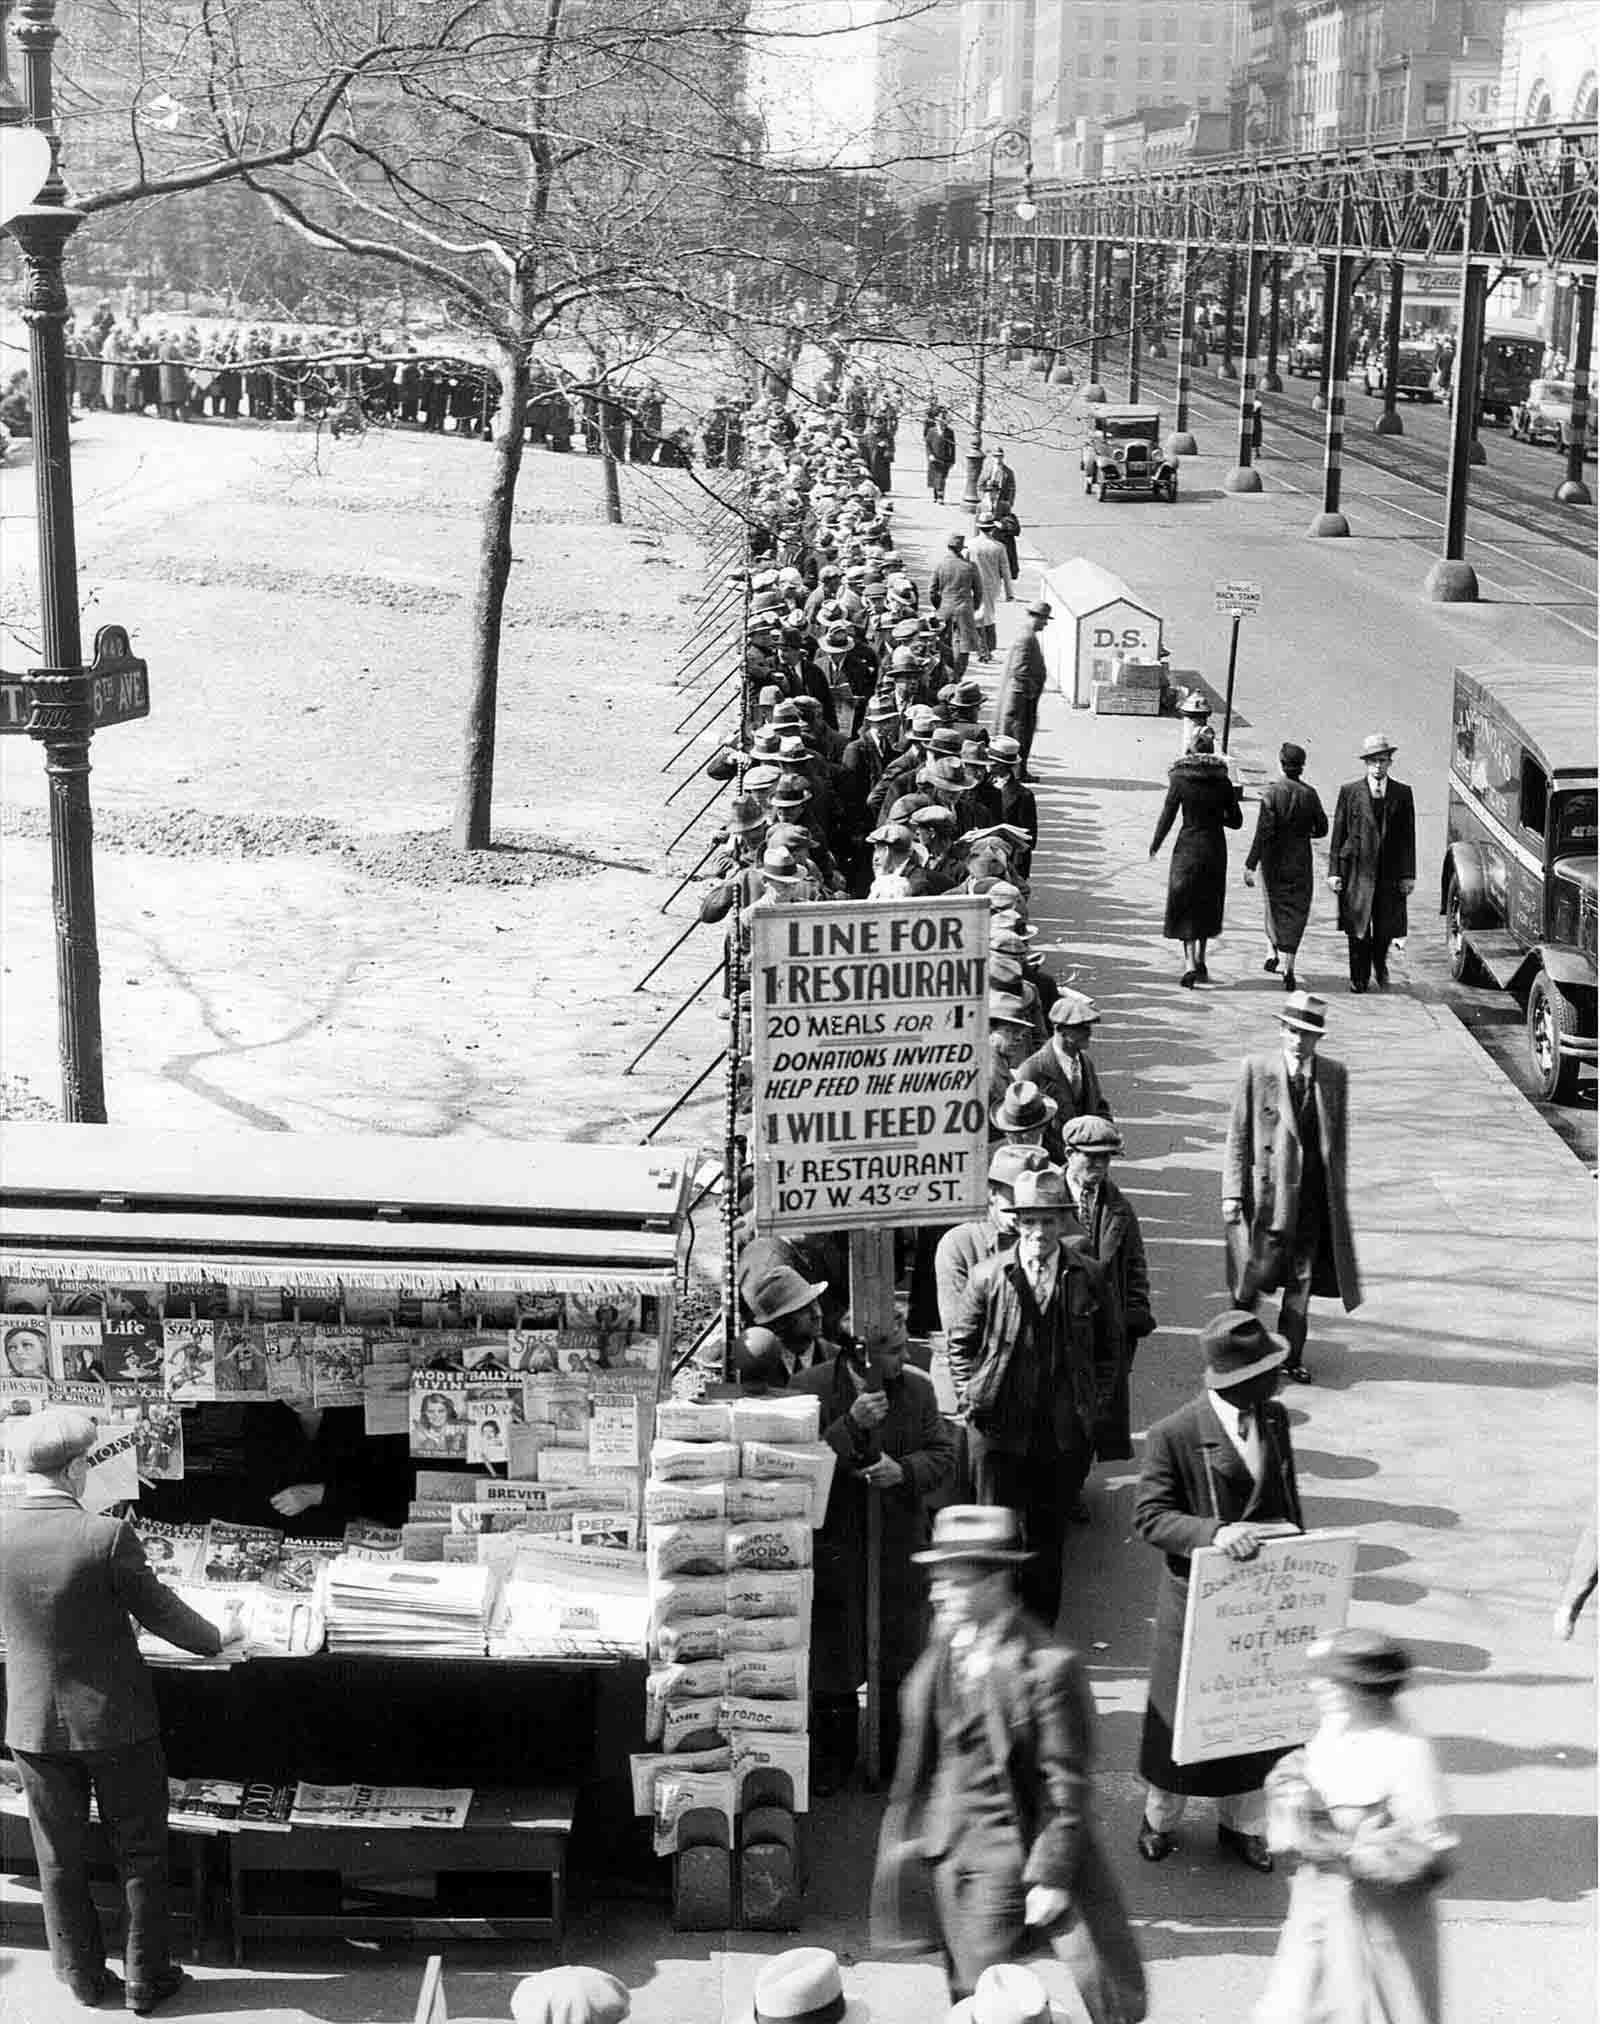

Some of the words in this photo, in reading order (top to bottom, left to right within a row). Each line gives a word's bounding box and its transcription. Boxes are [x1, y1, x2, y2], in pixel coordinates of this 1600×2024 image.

[118, 672, 145, 712] AVE
[788, 921, 880, 957] LINE
[891, 917, 964, 952] FOR
[789, 957, 986, 1004] RESTAURANT
[767, 1016, 800, 1038] 20
[807, 1014, 886, 1037] MEALS
[894, 1014, 933, 1032] FOR
[773, 1048, 887, 1072] DONATIONS
[893, 1044, 973, 1066] INVITED
[764, 1078, 812, 1099] HELP
[814, 1075, 860, 1097] FEED
[866, 1073, 896, 1094] THE
[898, 1069, 979, 1093] HUNGRY
[786, 1111, 857, 1144] WILL
[864, 1105, 937, 1139] FEED
[943, 1100, 985, 1134] 20
[802, 1152, 969, 1183] RESTAURANT
[779, 1189, 817, 1213] 107
[928, 1180, 963, 1202] ST.
[105, 1320, 145, 1335] Life
[1229, 1630, 1270, 1651] HOT
